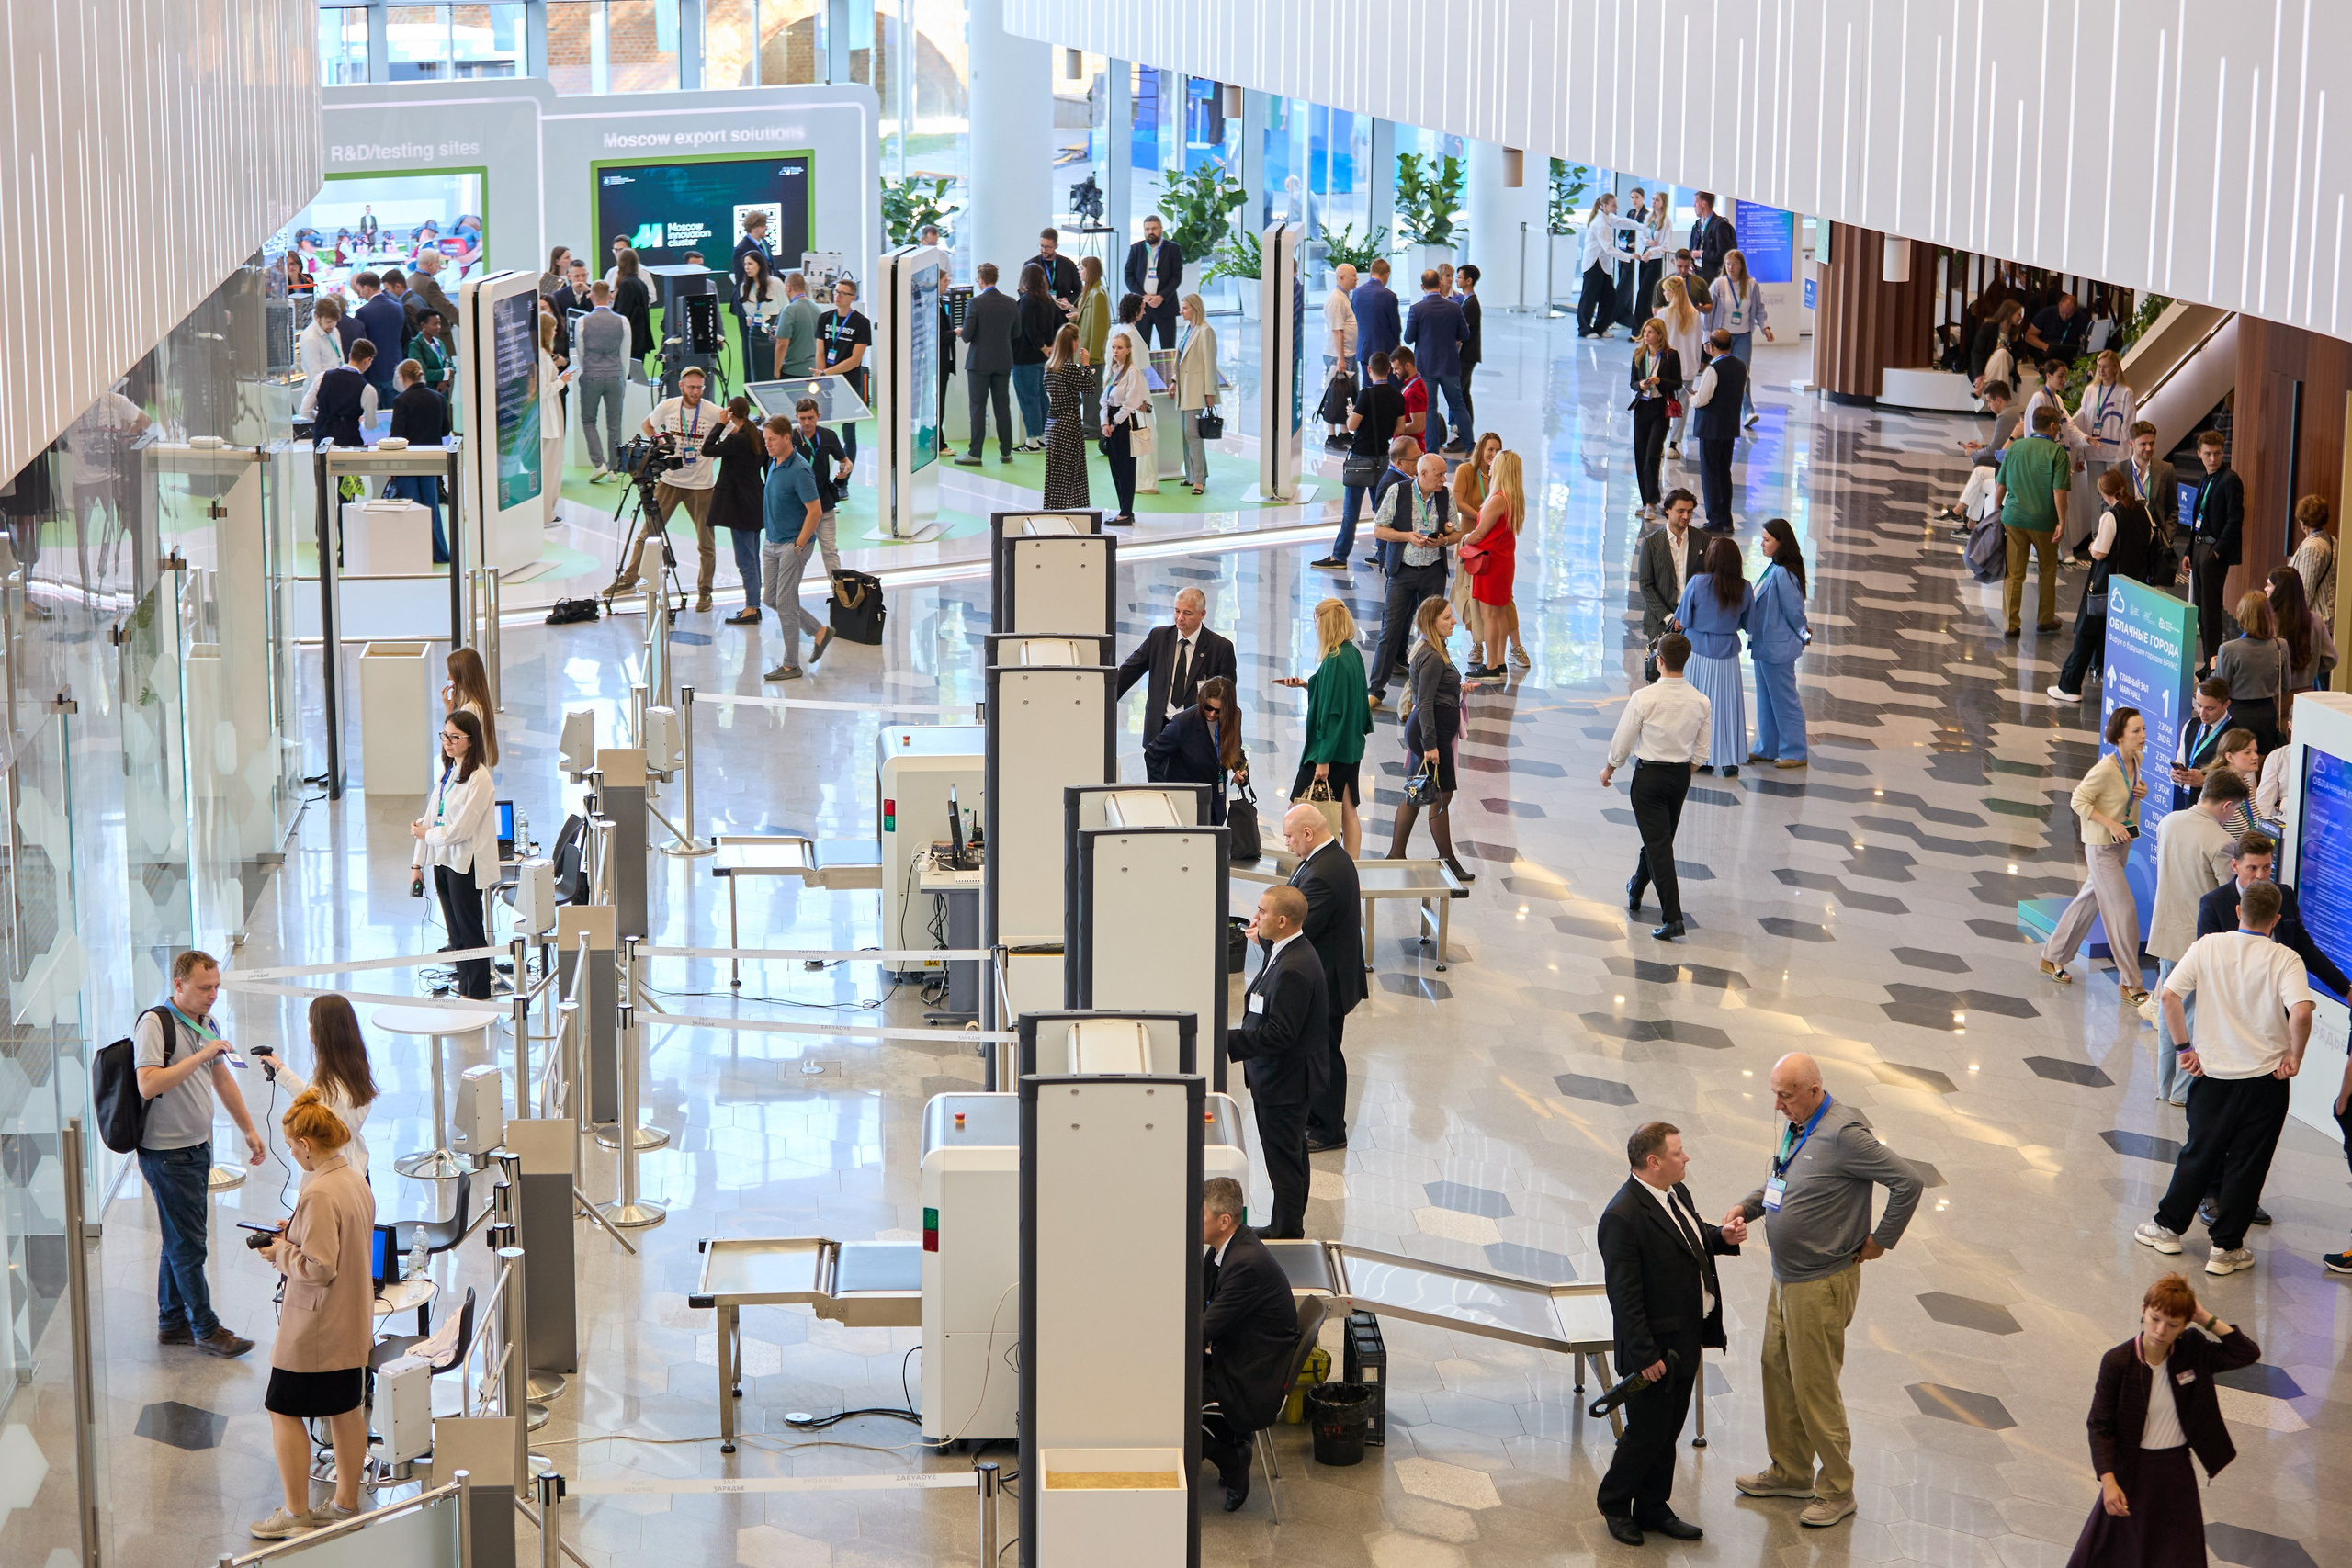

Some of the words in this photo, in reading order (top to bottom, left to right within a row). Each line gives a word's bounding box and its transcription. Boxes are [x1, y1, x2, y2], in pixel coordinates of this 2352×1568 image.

[603, 132, 671, 148] Moscow
[674, 128, 727, 147] export
[730, 126, 806, 142] solutions
[331, 142, 435, 162] R&D/testing
[439, 141, 480, 157] sites
[667, 222, 704, 231] Moscow
[667, 230, 711, 240] innovation
[667, 237, 698, 247] cluster
[2109, 616, 2149, 644] ОБЛАЧНЫЕ
[2149, 634, 2179, 658] ГОРОДА
[2109, 633, 2123, 646] Форум
[2126, 641, 2145, 656] будущем
[2144, 651, 2163, 665] городов
[2163, 658, 2178, 671] БРИКС
[2120, 671, 2141, 689] ГЛАВНЫЙ
[2140, 682, 2149, 694] ЗАЛ
[2119, 683, 2131, 696] MAIN
[2130, 689, 2141, 702] HALL
[2162, 689, 2169, 718] 1
[2157, 721, 2161, 730] 2
[2161, 722, 2173, 736] ЭТАЖ
[2156, 732, 2166, 744] 2ND
[2155, 750, 2159, 760] 2
[2154, 762, 2165, 774] 2ND
[2153, 782, 2158, 790] -1
[2158, 783, 2170, 796] ЭТАЖ
[2312, 776, 2347, 797] ОБЛАЧНЫЕ
[2312, 1024, 2346, 1054] РЯДЬЕ
[896, 1473, 936, 1482] ZARYADYE
